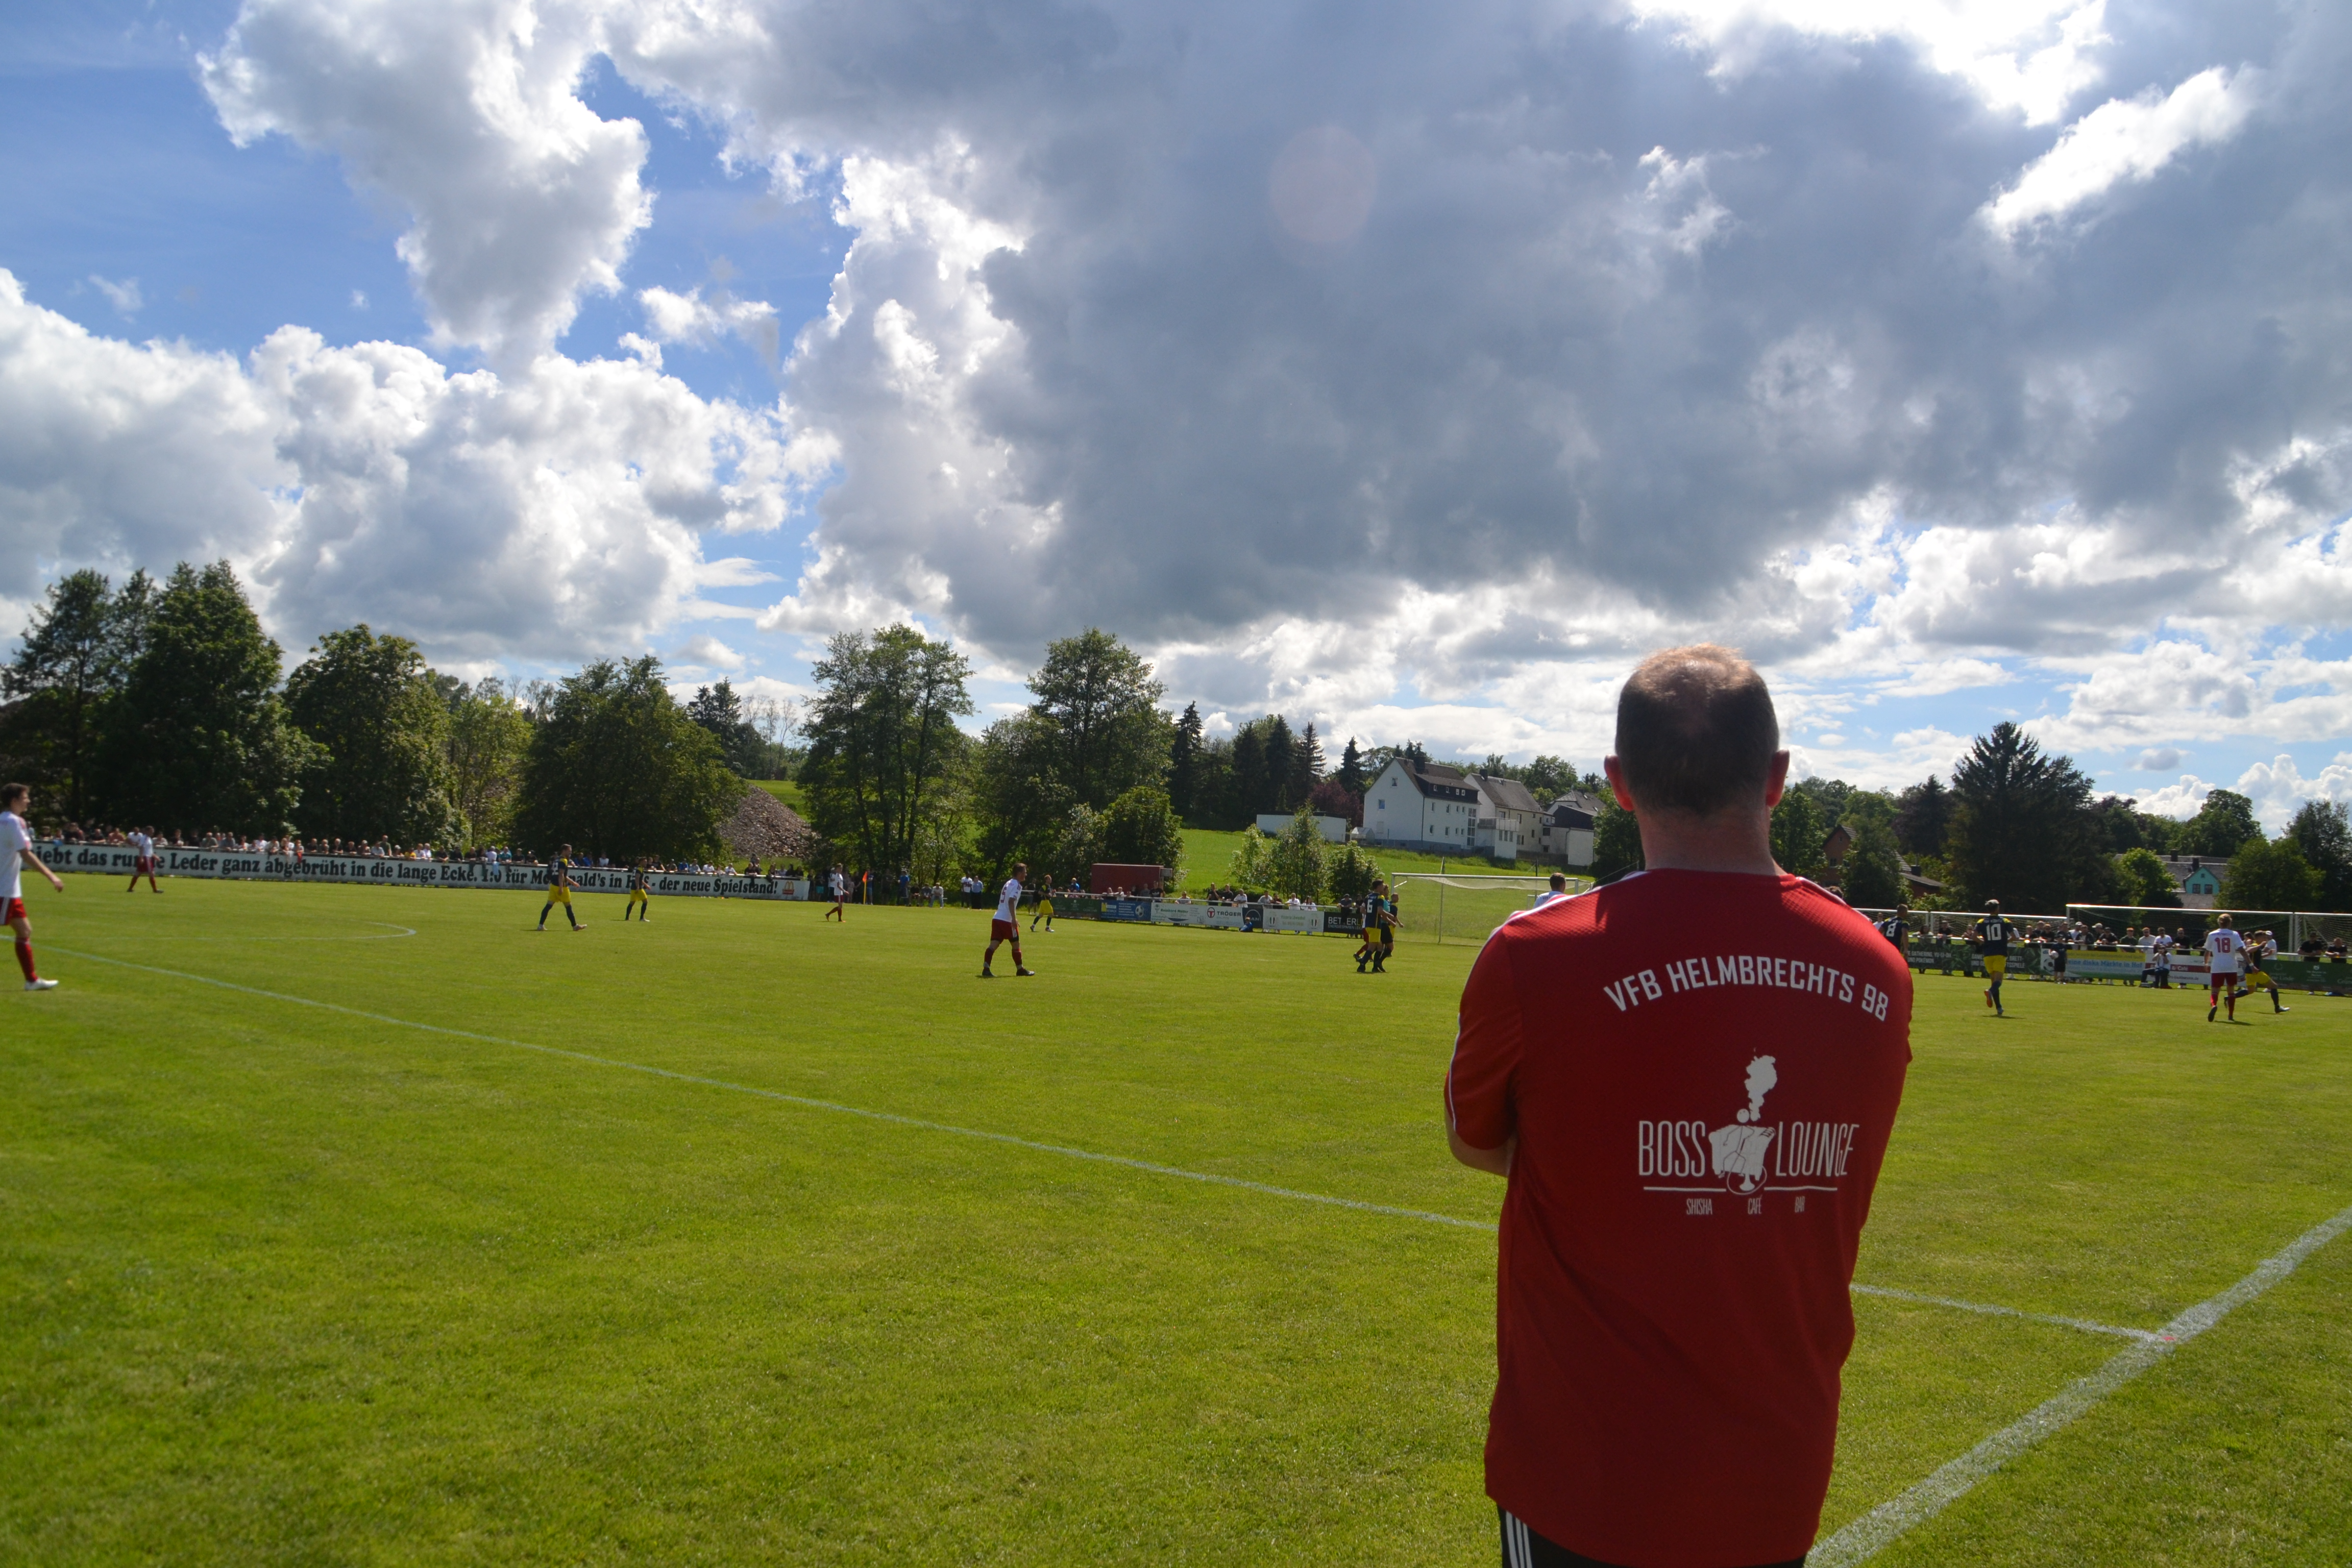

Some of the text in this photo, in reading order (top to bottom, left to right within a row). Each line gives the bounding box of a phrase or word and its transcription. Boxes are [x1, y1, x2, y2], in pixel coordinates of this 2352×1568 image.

[31, 846, 72, 865] iebt
[78, 848, 107, 866] das
[112, 851, 165, 868] rue
[170, 852, 218, 871] Leder
[222, 858, 260, 875] ganz
[265, 857, 347, 878] abgebrüht
[351, 861, 366, 877] in
[371, 862, 394, 878] die
[397, 863, 436, 883] lange
[440, 865, 478, 882] Ecke.
[482, 869, 502, 883] 1:0
[505, 868, 527, 884] für
[531, 869, 606, 887] Mcnald's
[609, 874, 622, 888] in
[659, 876, 679, 890] der
[682, 879, 710, 892] neue
[714, 878, 778, 895] Spielstand!
[1367, 899, 1373, 913] 6
[1886, 923, 1896, 937] 8
[1986, 923, 2001, 941] 10
[2214, 937, 2230, 953] 18
[1603, 955, 1889, 1022] VFB HELMBRECHTS 98
[1638, 1120, 1860, 1177] BOSS LOUNGE
[1686, 1198, 1713, 1215] SHISHA
[1794, 1196, 1805, 1213] BAR
